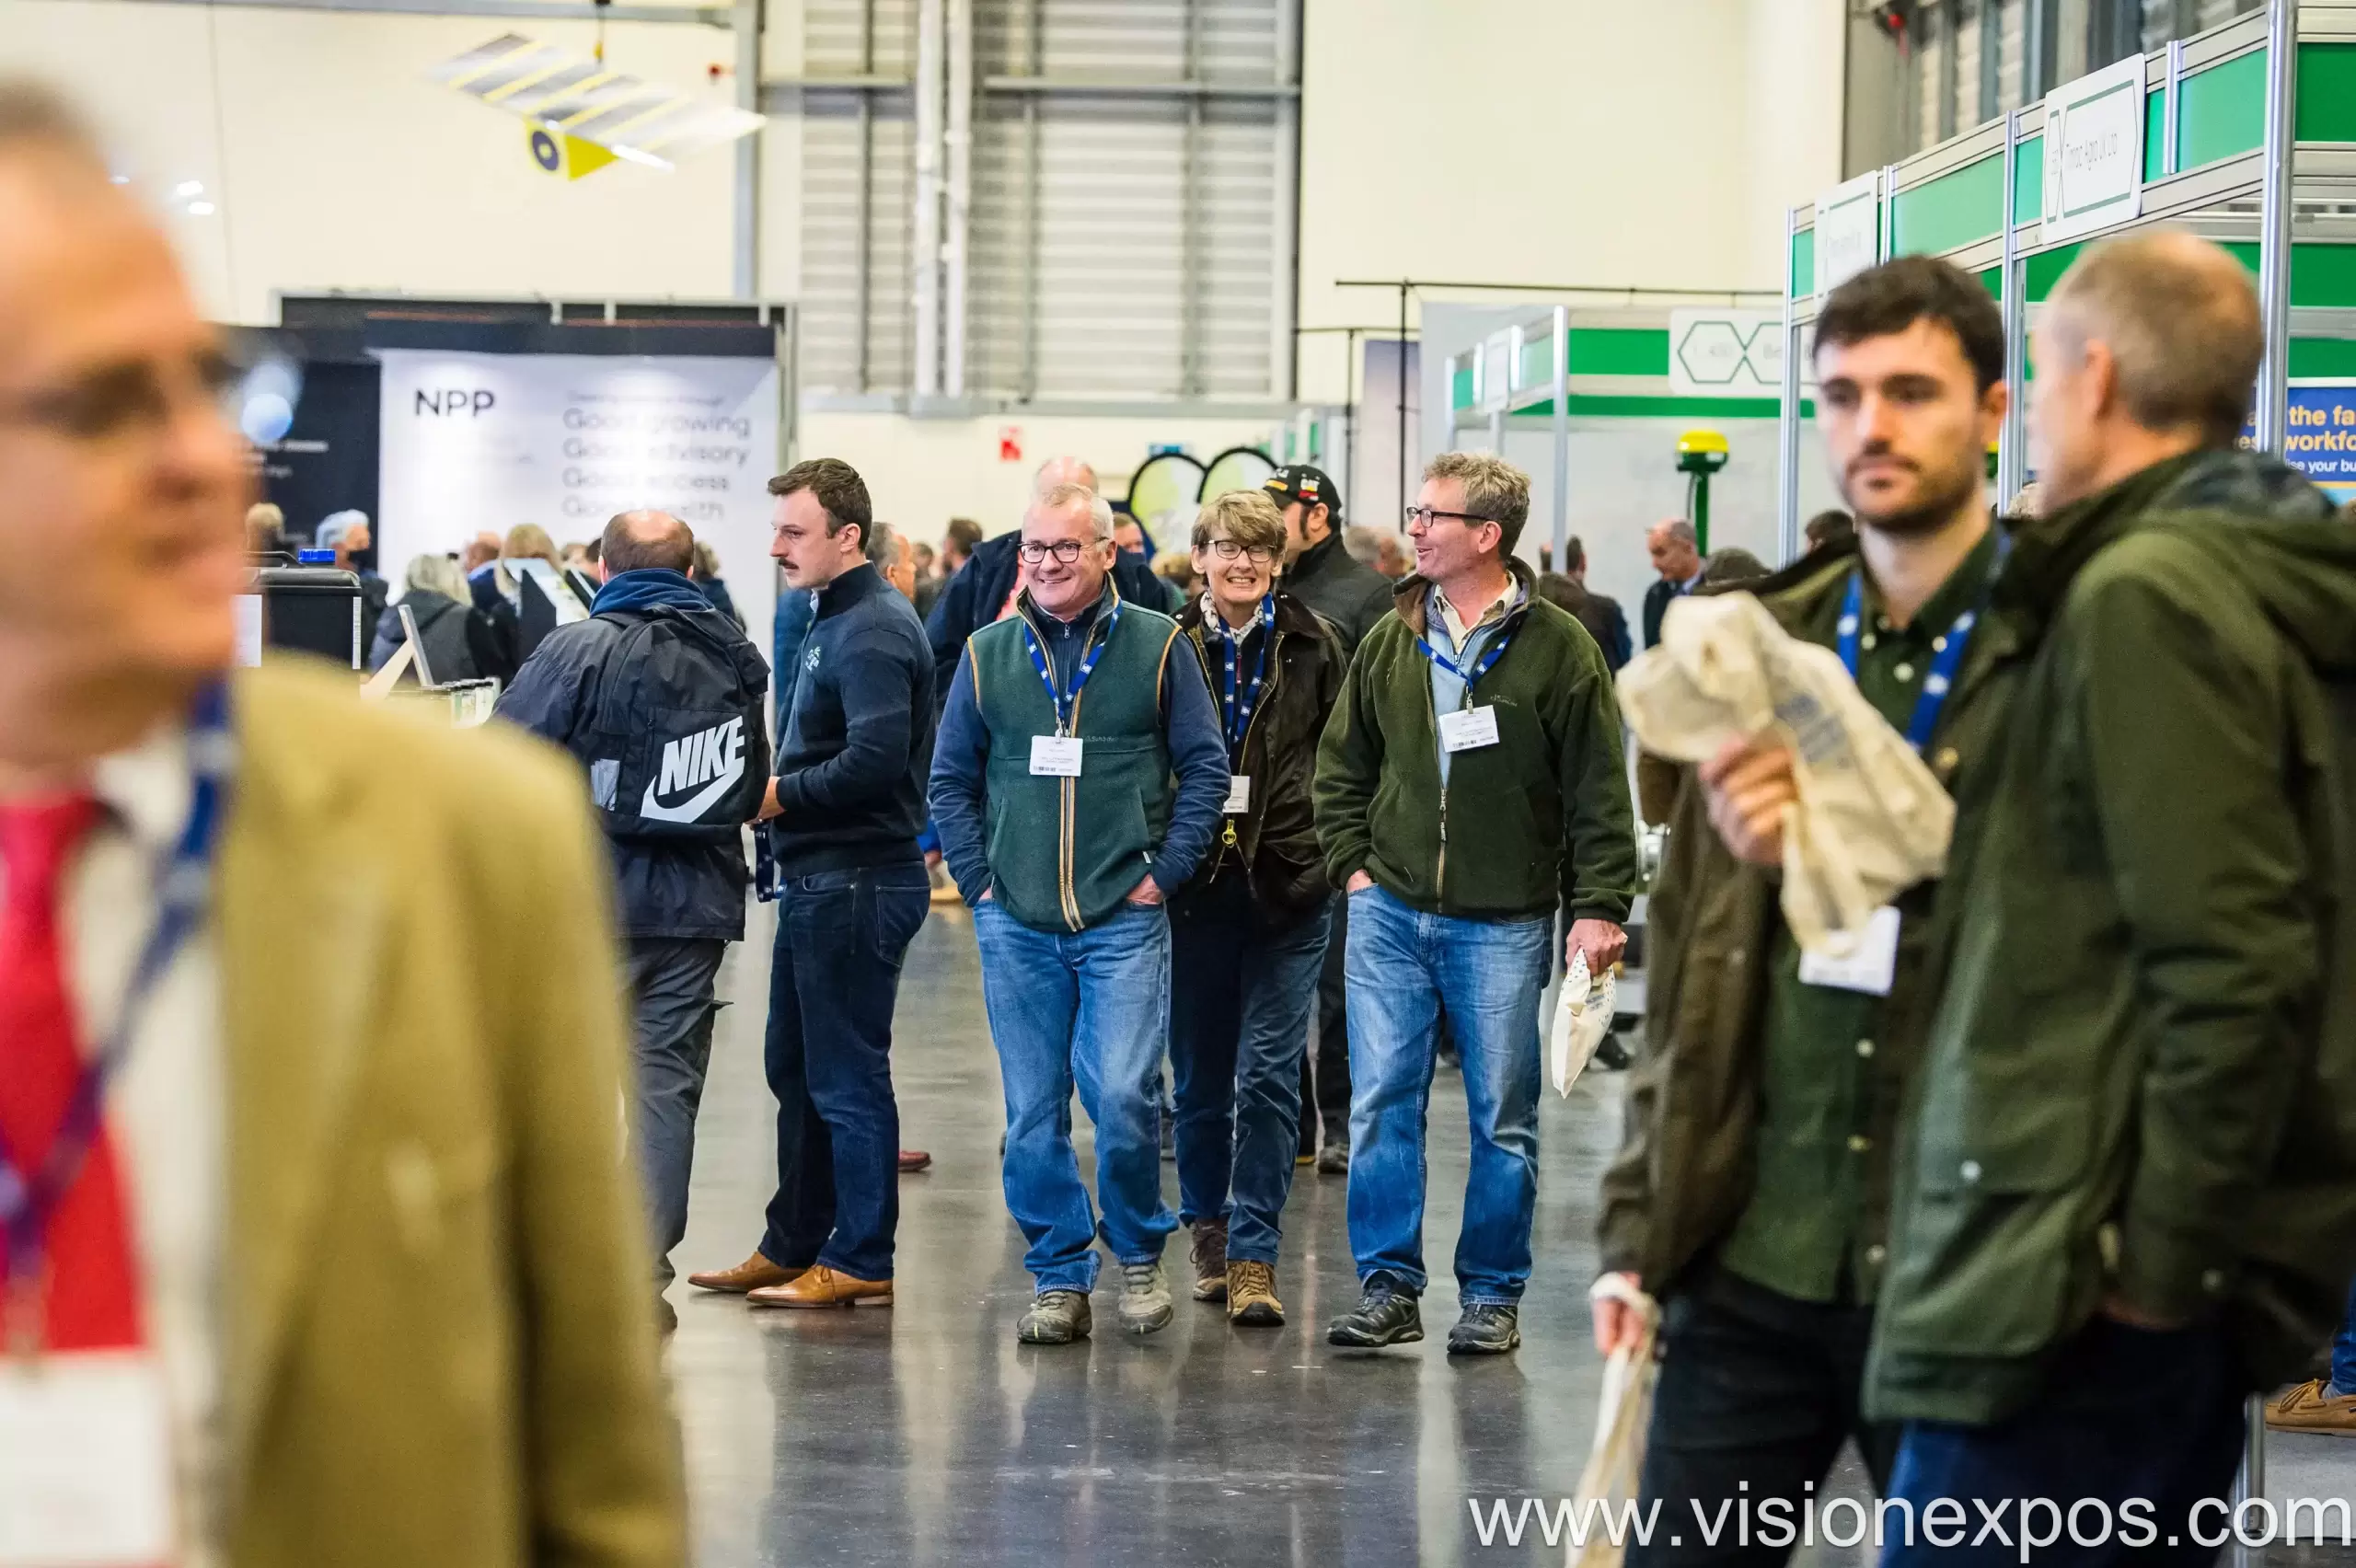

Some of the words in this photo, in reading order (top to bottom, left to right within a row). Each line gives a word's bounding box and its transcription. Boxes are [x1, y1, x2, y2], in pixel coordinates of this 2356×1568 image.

[415, 389, 494, 417] NPP
[562, 408, 635, 430] Goo
[2289, 405, 2327, 426] the
[562, 437, 635, 459] Goo
[2307, 462, 2339, 475] your
[562, 495, 635, 517] Goo
[658, 715, 745, 796] NIKE
